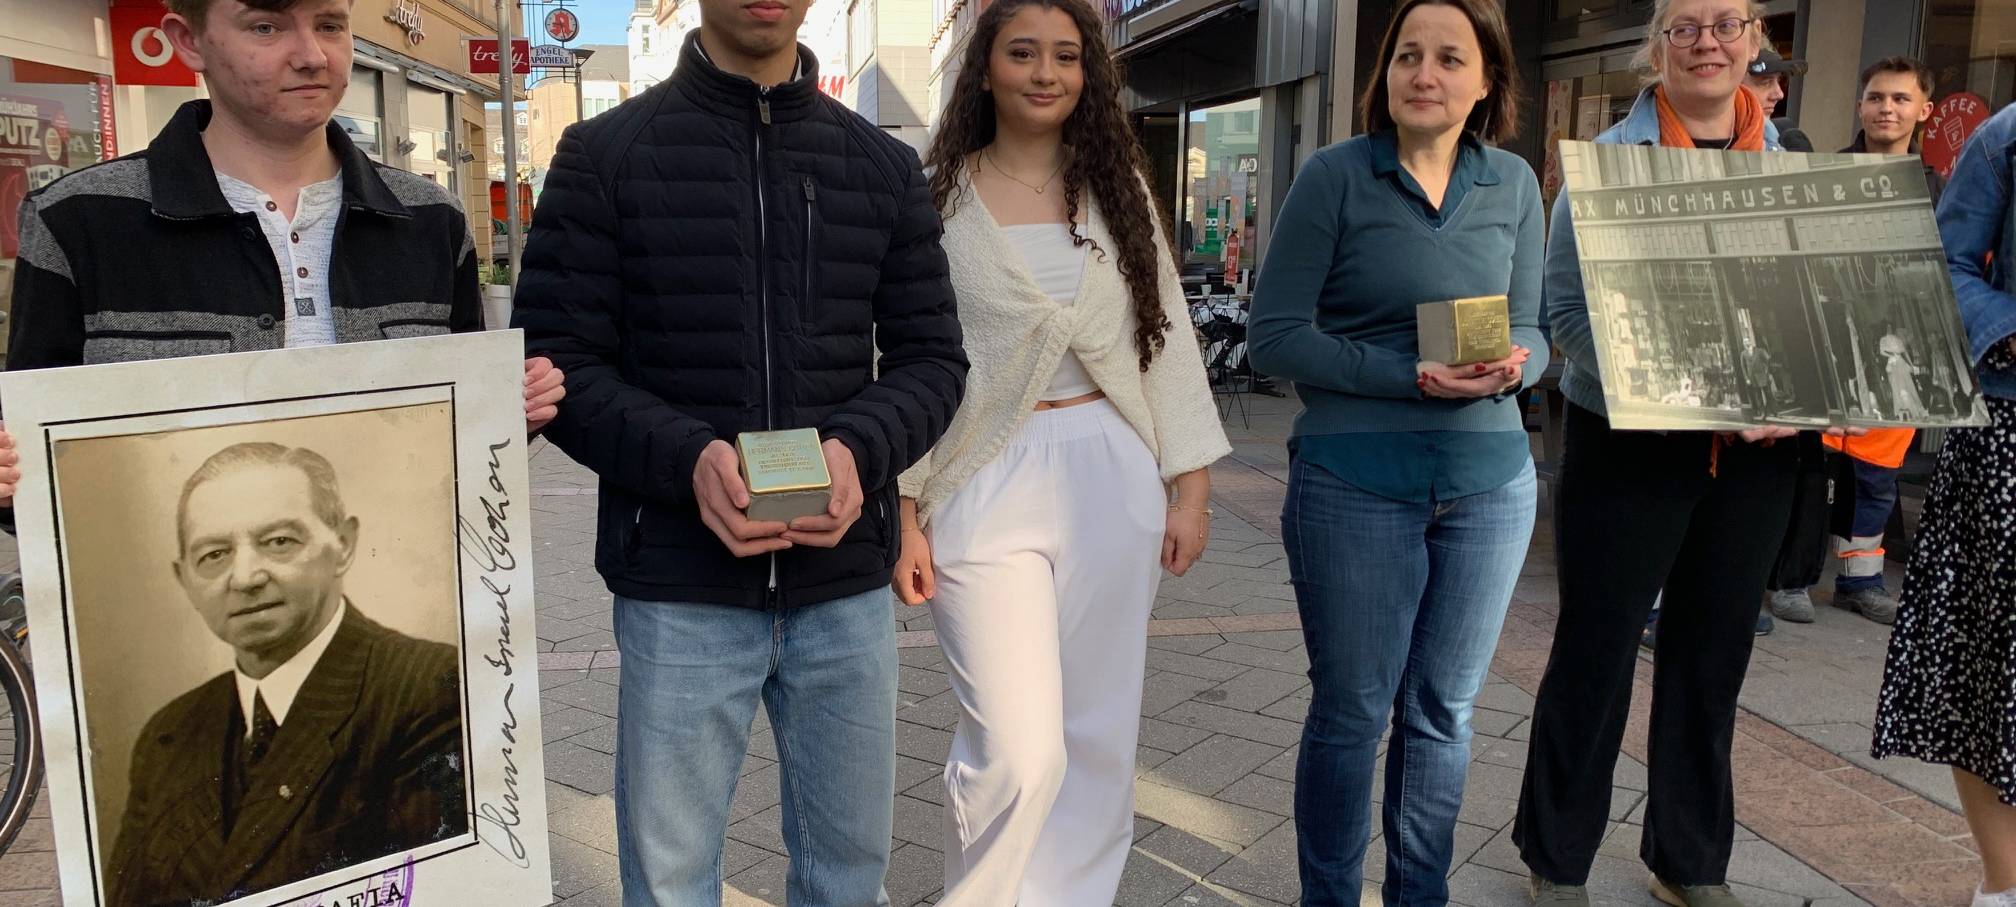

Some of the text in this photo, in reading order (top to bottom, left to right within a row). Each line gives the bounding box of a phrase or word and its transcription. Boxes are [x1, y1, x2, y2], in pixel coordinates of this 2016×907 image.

[472, 45, 527, 70] trey
[530, 56, 570, 64] APOTHEKE
[1926, 98, 1977, 139] KAFFEE
[1615, 180, 1819, 216] MÜNCHHAUSEN
[1832, 184, 1846, 201] &
